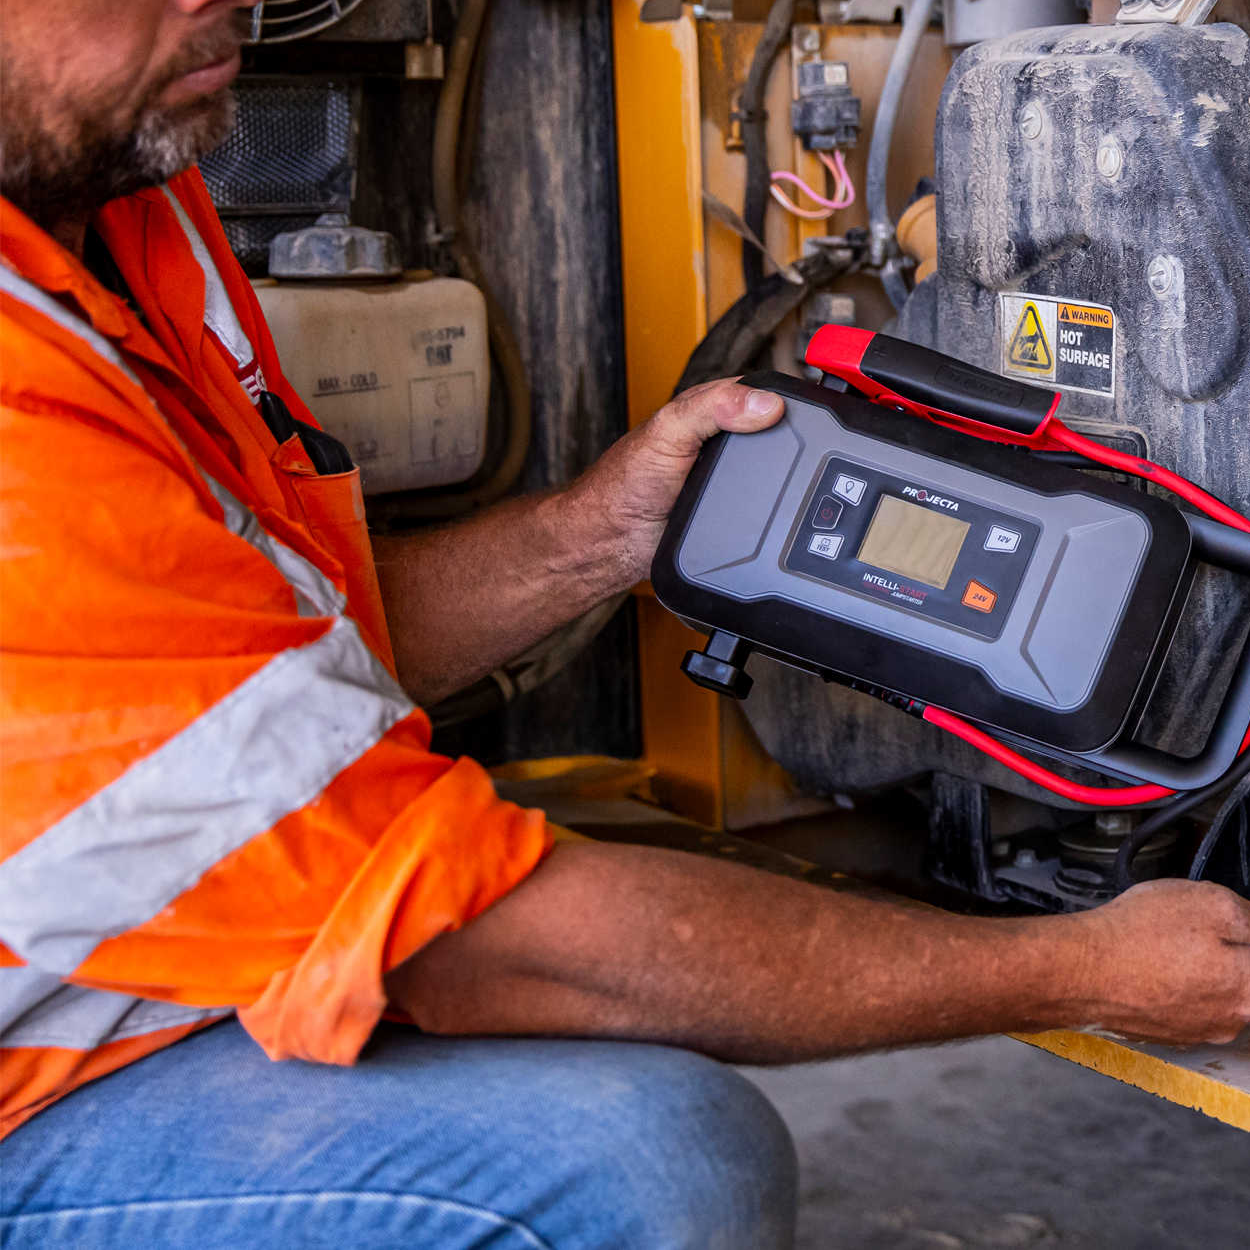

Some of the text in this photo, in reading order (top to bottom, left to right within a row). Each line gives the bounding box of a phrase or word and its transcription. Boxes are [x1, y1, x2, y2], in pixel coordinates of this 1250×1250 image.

[1072, 310, 1109, 325] WARNING
[1060, 329, 1083, 346] HOT
[1060, 347, 1110, 369] SURFACE
[318, 377, 345, 392] MAX
[351, 372, 378, 388] COLD
[902, 486, 960, 512] PROJECTA
[816, 544, 830, 552] TEST
[997, 535, 1012, 545] 12V
[862, 572, 928, 601] INTELLI-START
[890, 592, 924, 606] JUMPSTARTER
[972, 593, 988, 603] 24V
